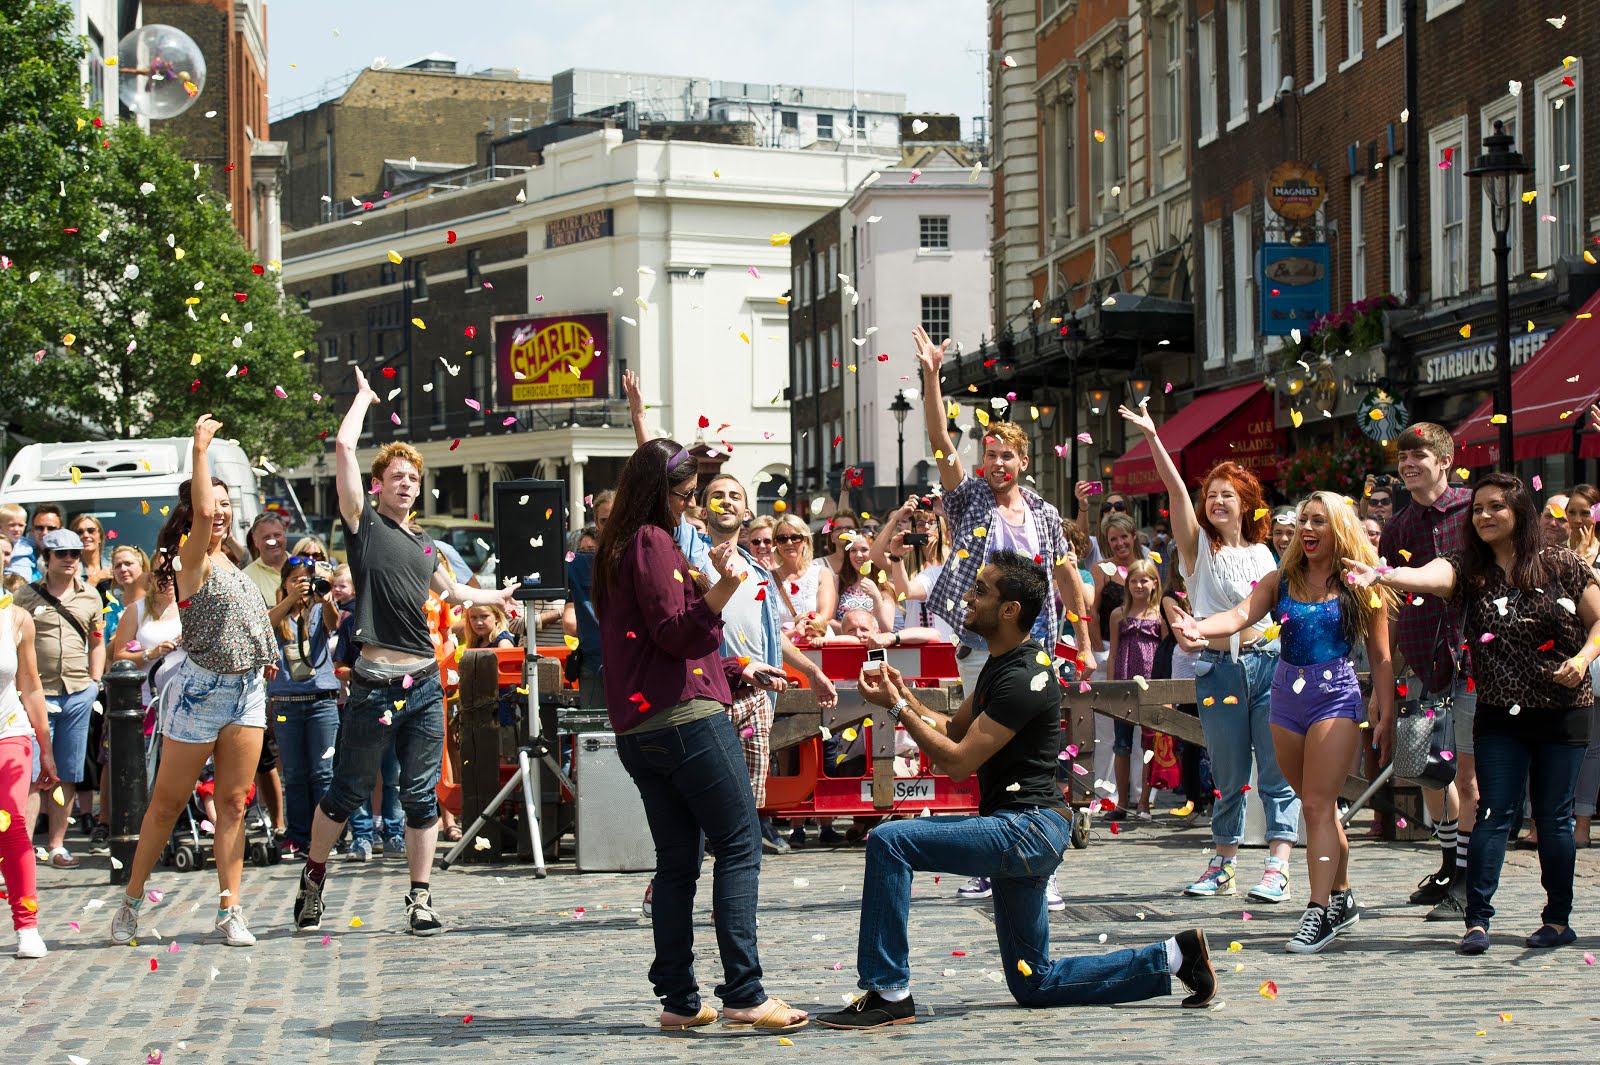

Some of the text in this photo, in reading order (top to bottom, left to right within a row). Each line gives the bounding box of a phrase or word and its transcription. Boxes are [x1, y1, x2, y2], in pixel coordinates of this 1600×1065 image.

[1275, 187, 1318, 197] MAGNERS
[545, 208, 608, 236] THEATRE ROYAL
[551, 223, 601, 248] DRURY LANE
[513, 324, 589, 377] CHARLIE
[1426, 345, 1497, 384] STARBUCKS
[521, 384, 560, 398] CHOCOLATE
[561, 381, 590, 396] FACTORY
[1231, 438, 1274, 453] SALADES
